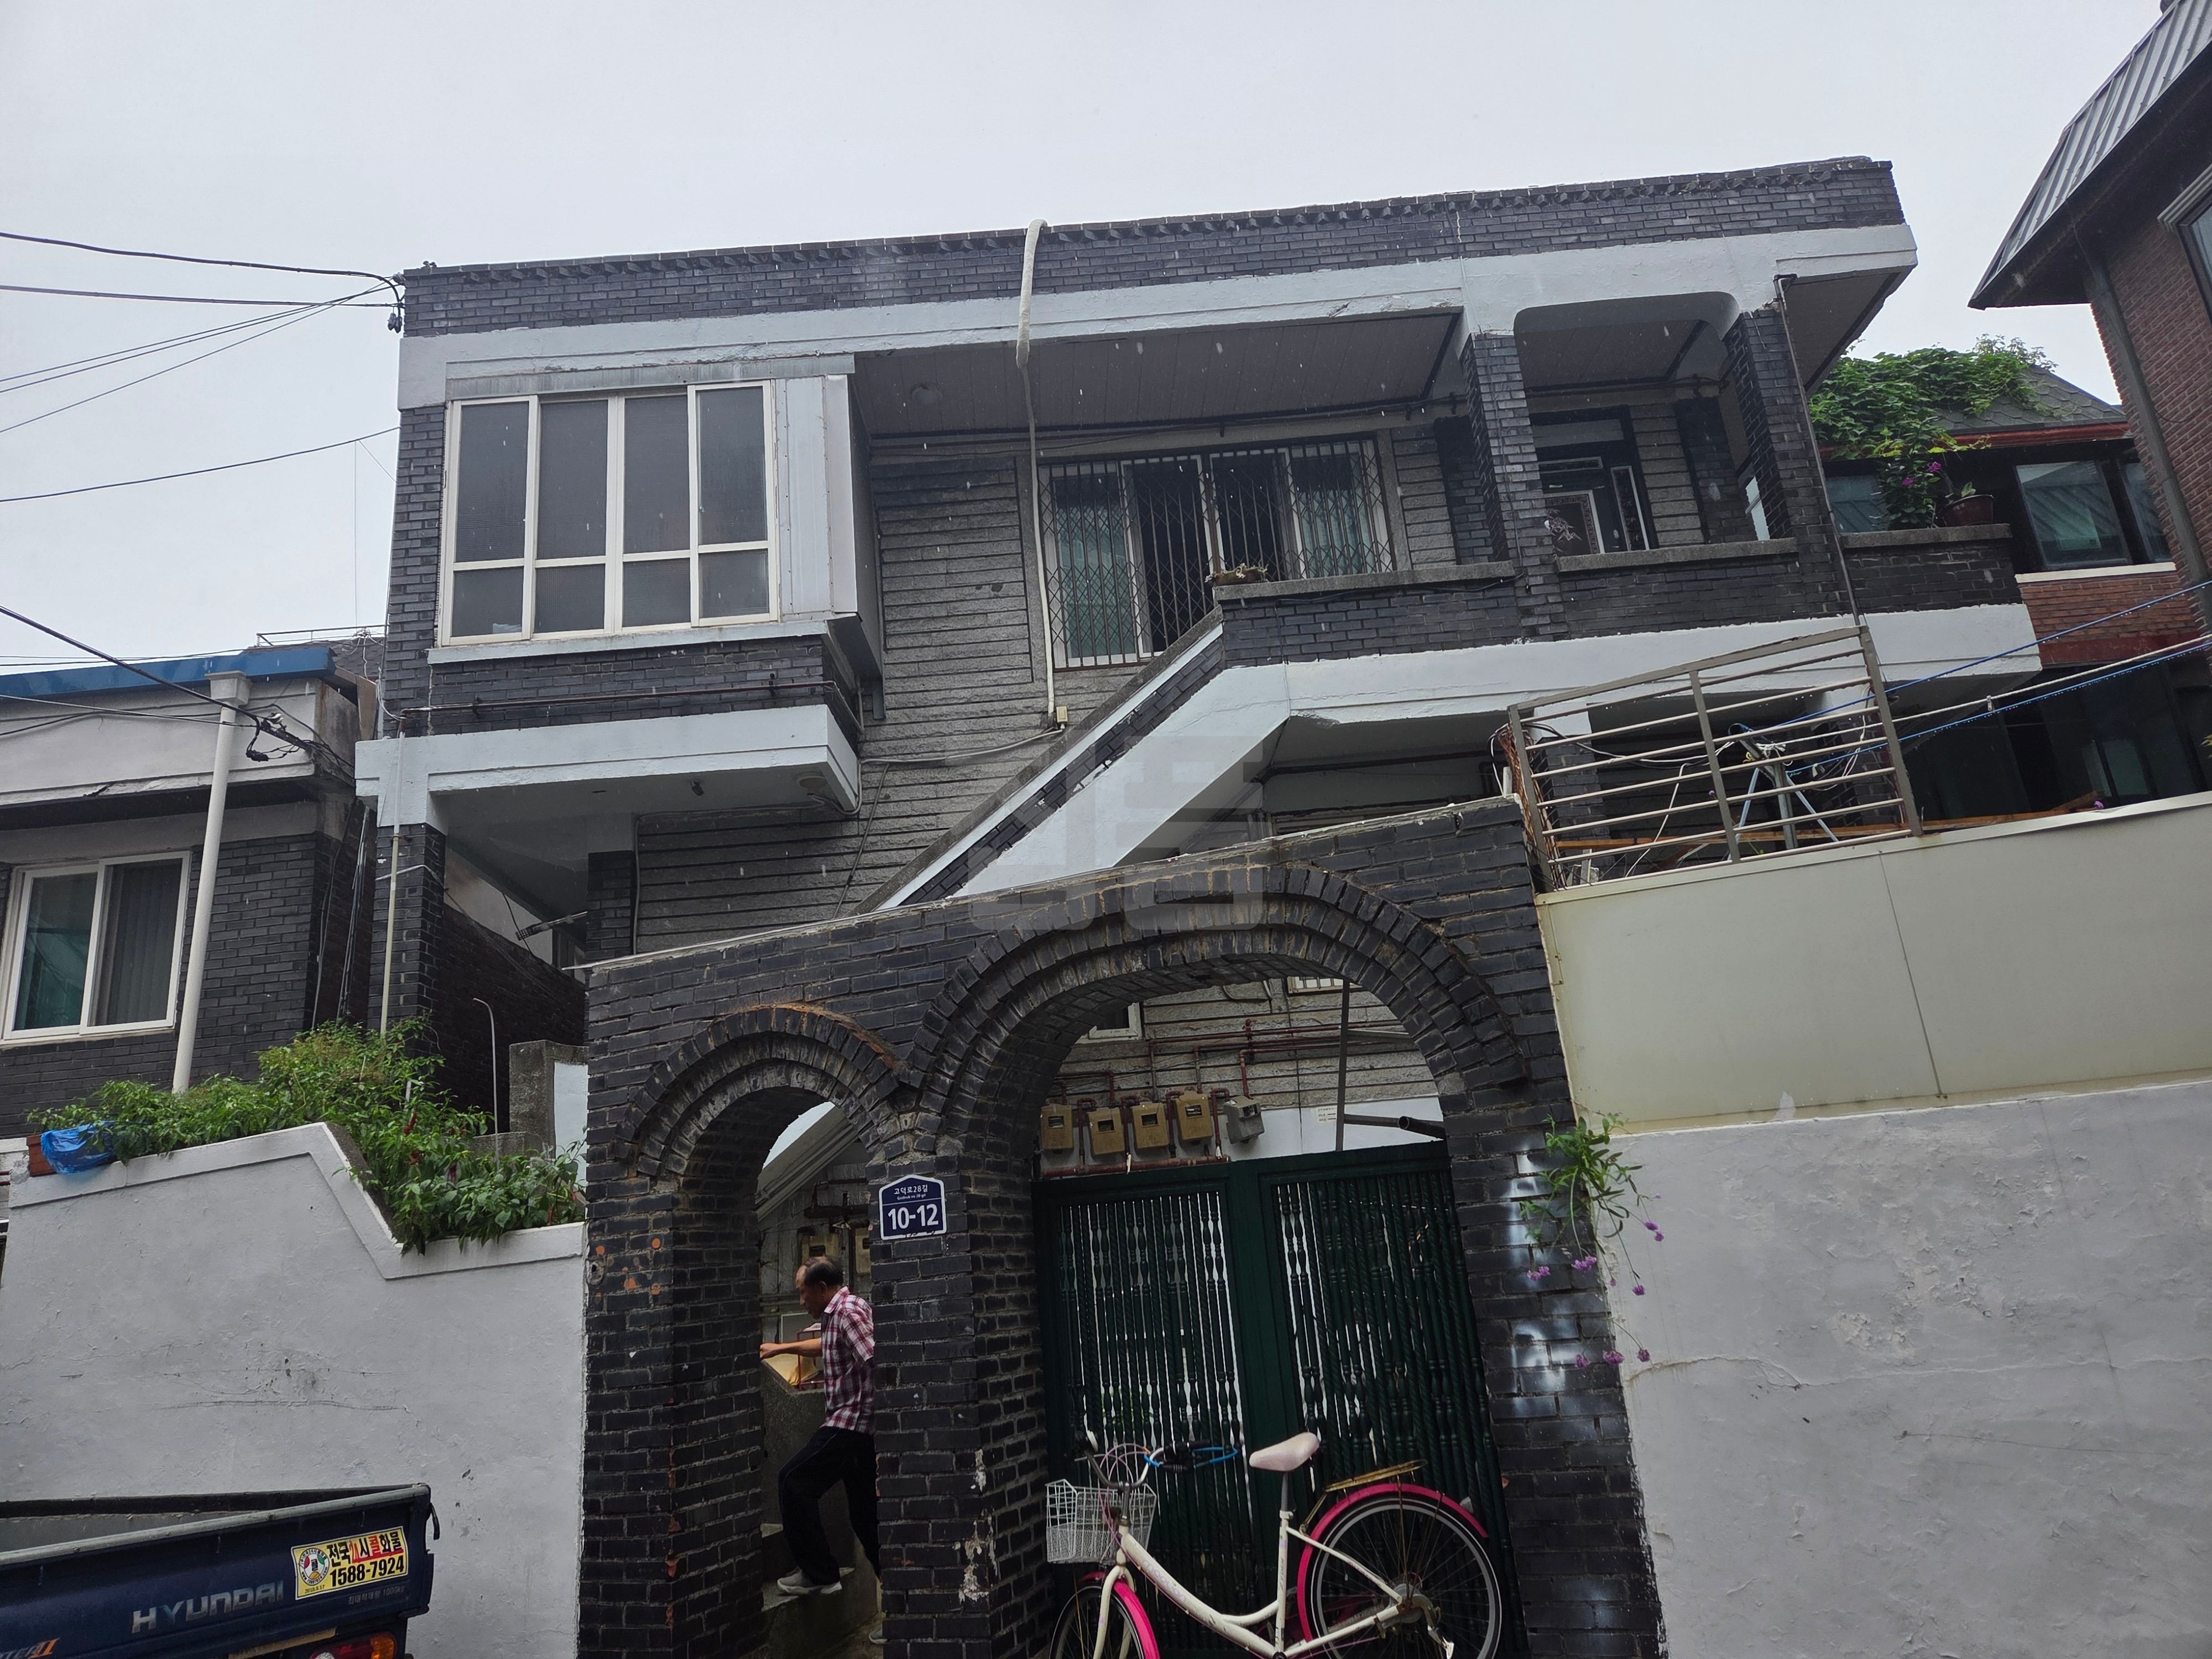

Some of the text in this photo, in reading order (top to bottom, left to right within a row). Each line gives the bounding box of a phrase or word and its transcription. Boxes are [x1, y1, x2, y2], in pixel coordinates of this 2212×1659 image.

[888, 1203, 939, 1230] 10-12
[330, 1555, 404, 1587] 1588-7924
[132, 1580, 284, 1634] HYUNDAI
